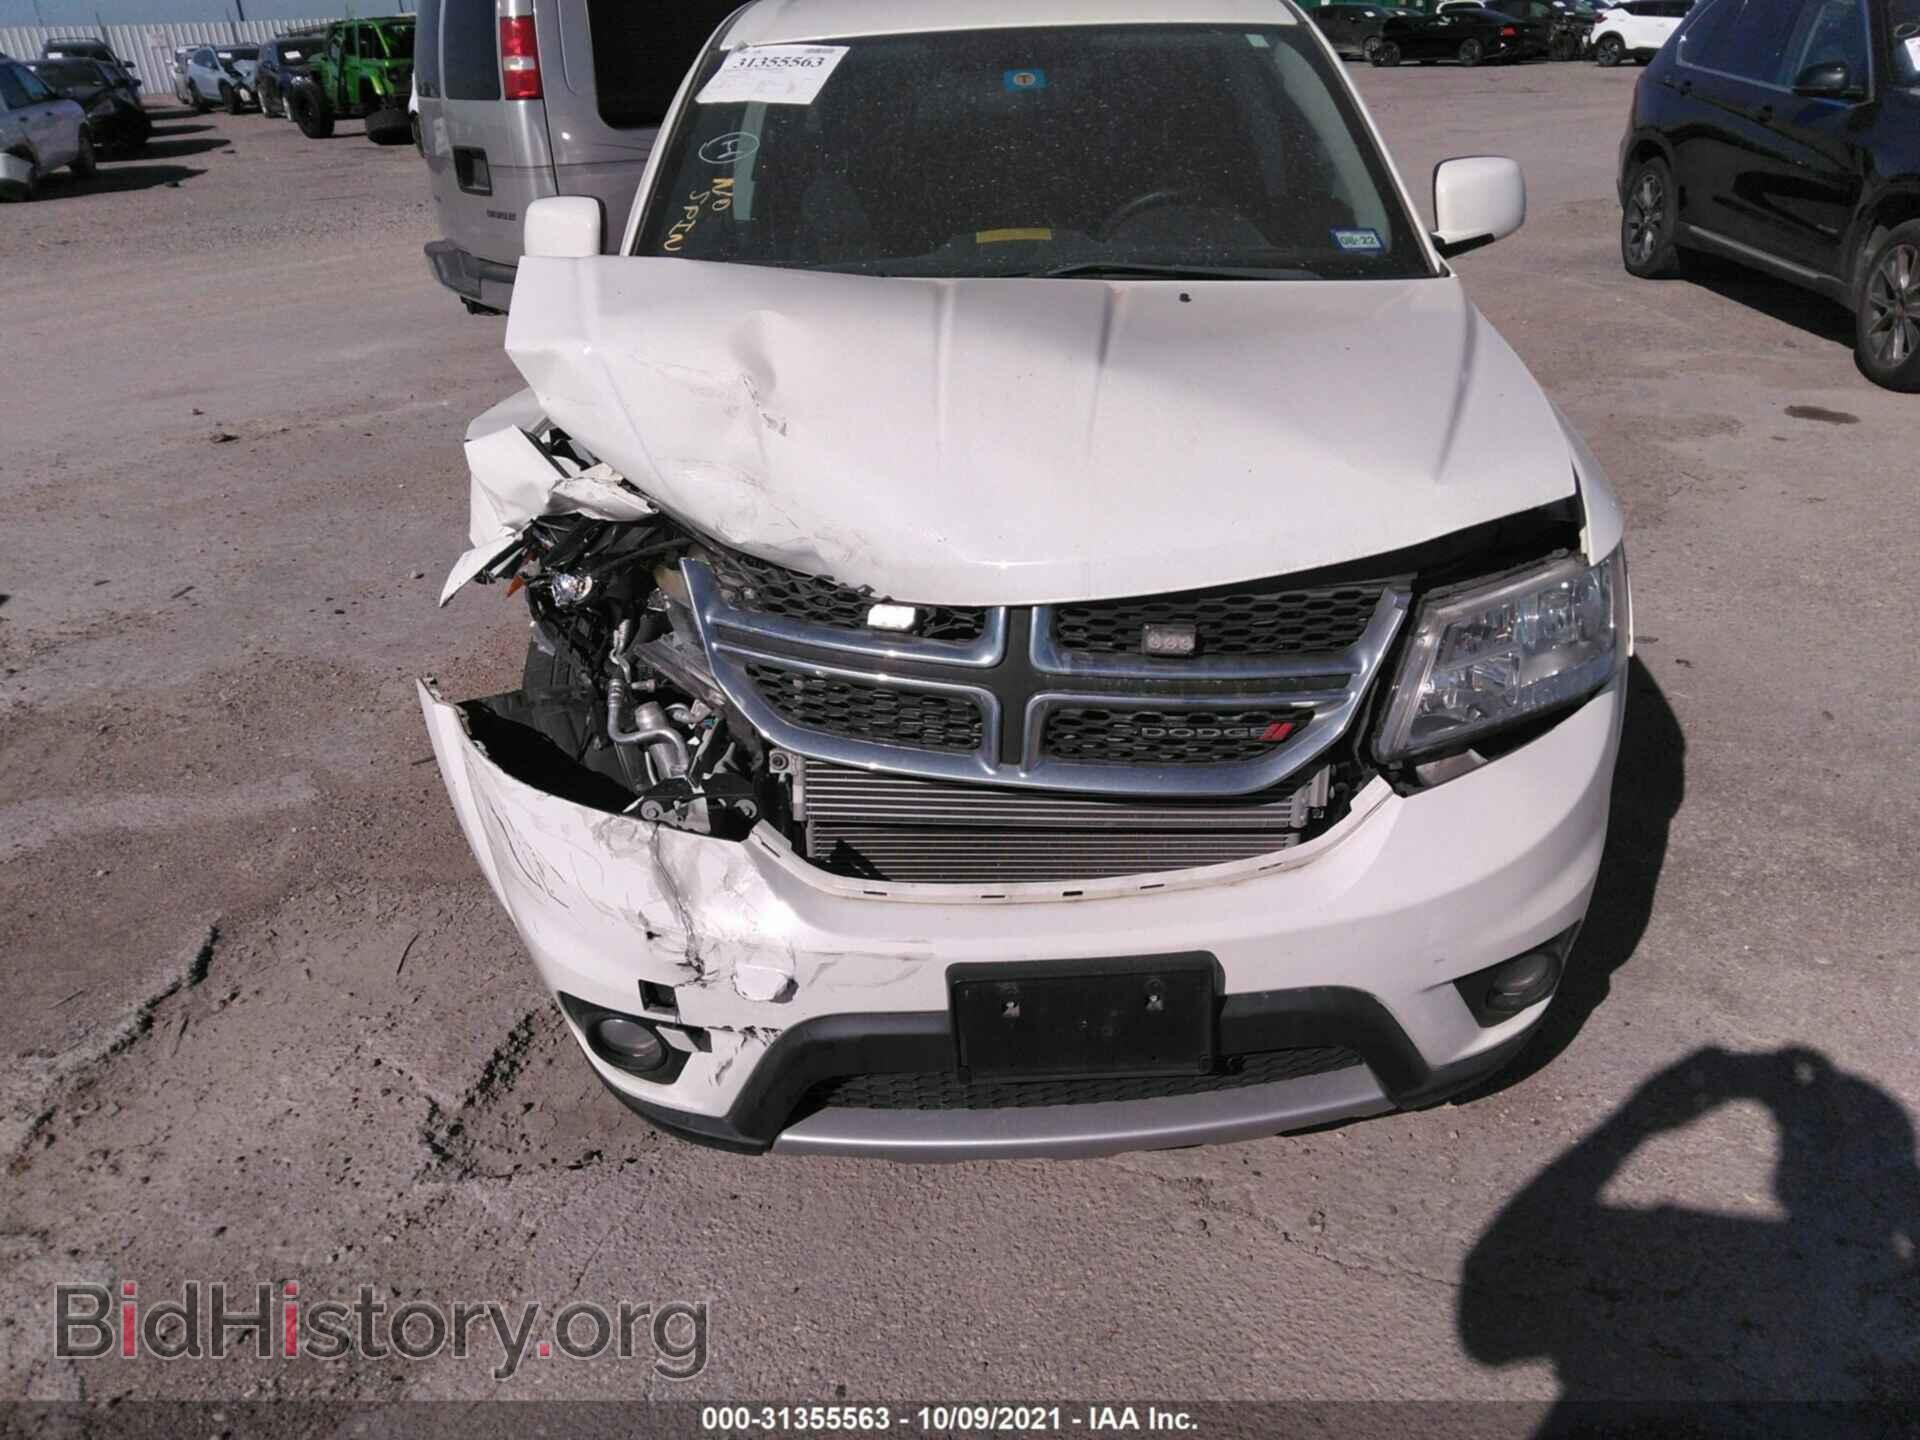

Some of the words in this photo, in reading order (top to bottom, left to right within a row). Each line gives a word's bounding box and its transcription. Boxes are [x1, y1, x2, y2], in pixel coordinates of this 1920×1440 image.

[733, 56, 825, 69] 31355563
[711, 178, 736, 212] NO
[1141, 727, 1266, 738] DODGE
